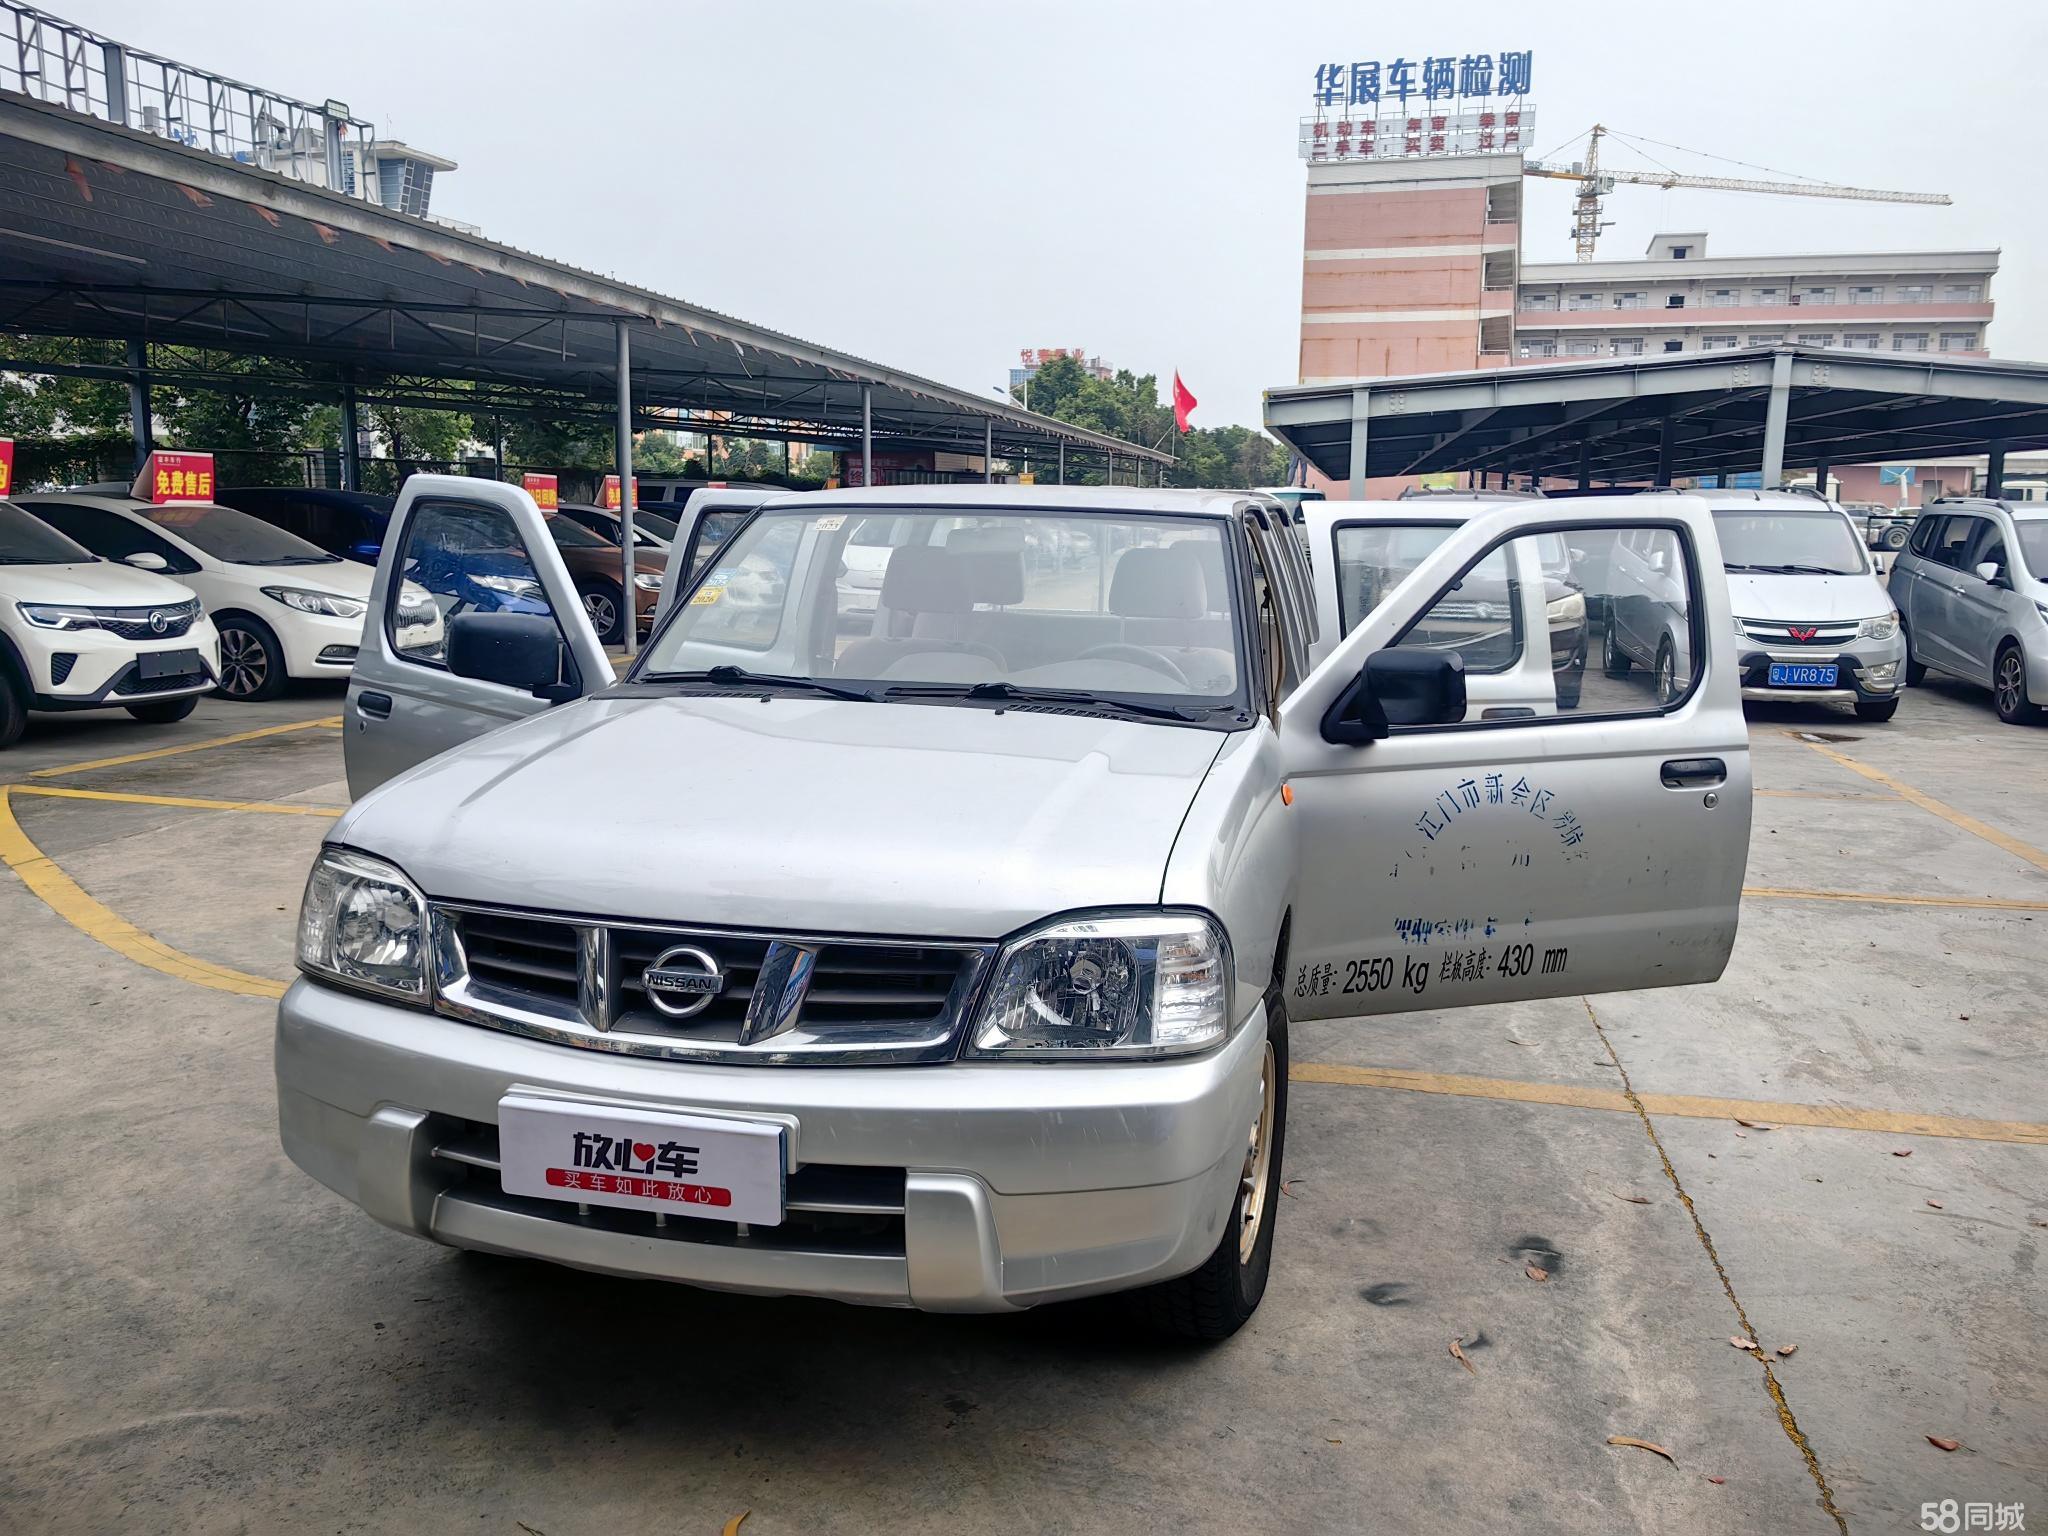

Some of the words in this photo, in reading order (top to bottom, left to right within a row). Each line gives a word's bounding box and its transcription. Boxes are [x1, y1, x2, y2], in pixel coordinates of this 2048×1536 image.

[1313, 50, 1533, 107] 华展车辆检测
[156, 469, 212, 496] 免费售后
[647, 974, 712, 990] NISSAN
[1342, 956, 1394, 994] 2550
[1402, 954, 1430, 995] kg
[1497, 943, 1534, 978] 430
[1541, 947, 1568, 974] mm
[573, 1131, 701, 1178] 放心车
[563, 1170, 713, 1204] 买车如此放心
